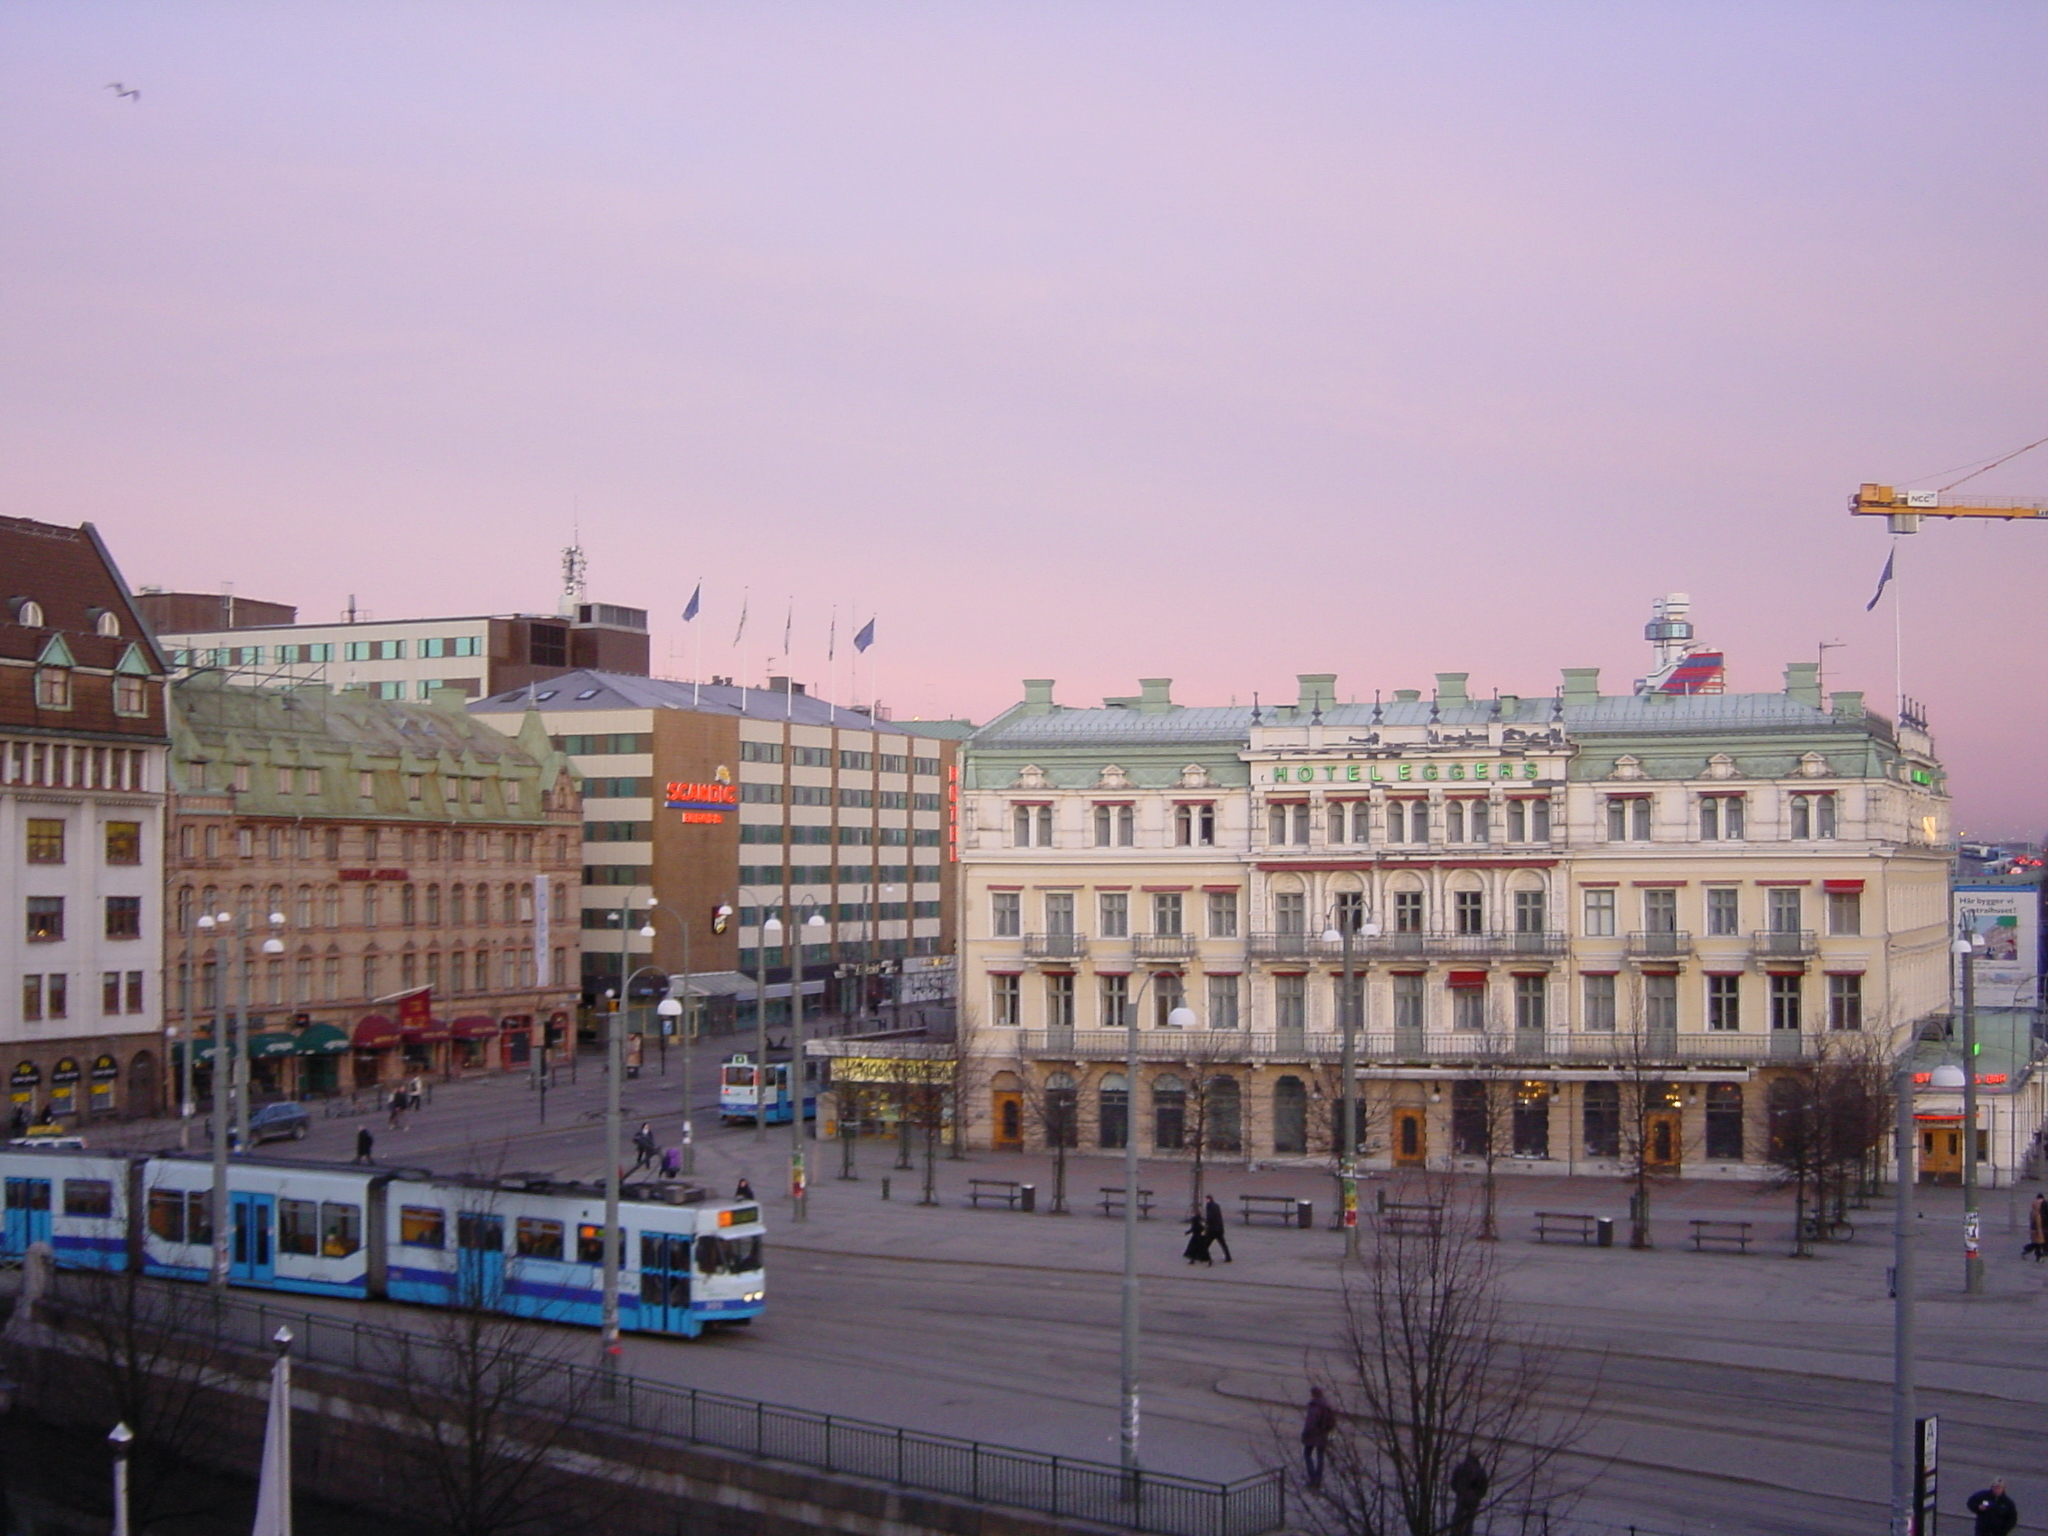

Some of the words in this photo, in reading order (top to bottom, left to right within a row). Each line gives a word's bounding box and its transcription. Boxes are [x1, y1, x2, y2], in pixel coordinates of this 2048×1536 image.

[1910, 495, 1930, 503] NCC
[1273, 764, 1383, 782] HOTEL
[1398, 762, 1539, 781] EGGERS
[666, 782, 737, 803] SCANDIC
[948, 765, 958, 863] HOTEL
